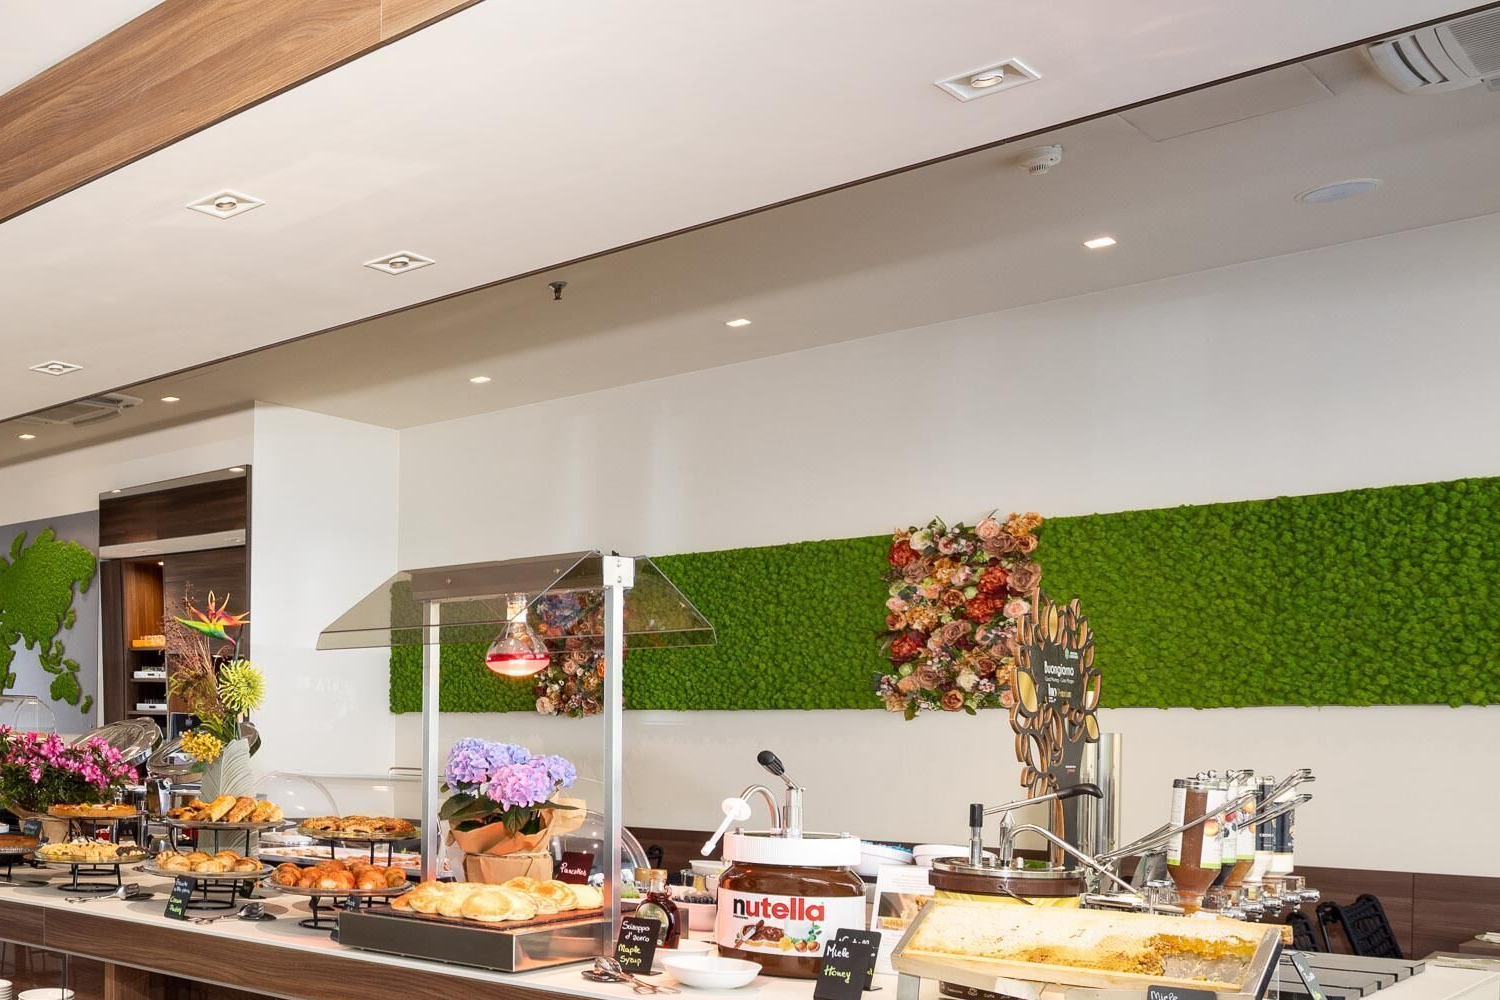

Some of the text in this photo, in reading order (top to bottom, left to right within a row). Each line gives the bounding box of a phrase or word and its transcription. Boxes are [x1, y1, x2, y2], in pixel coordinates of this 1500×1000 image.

[560, 862, 587, 877] Pancakes
[733, 897, 825, 921] nutella
[618, 943, 641, 956] Maple
[826, 943, 850, 958] Miele
[620, 956, 642, 967] Syrup
[824, 964, 851, 984] Honey
